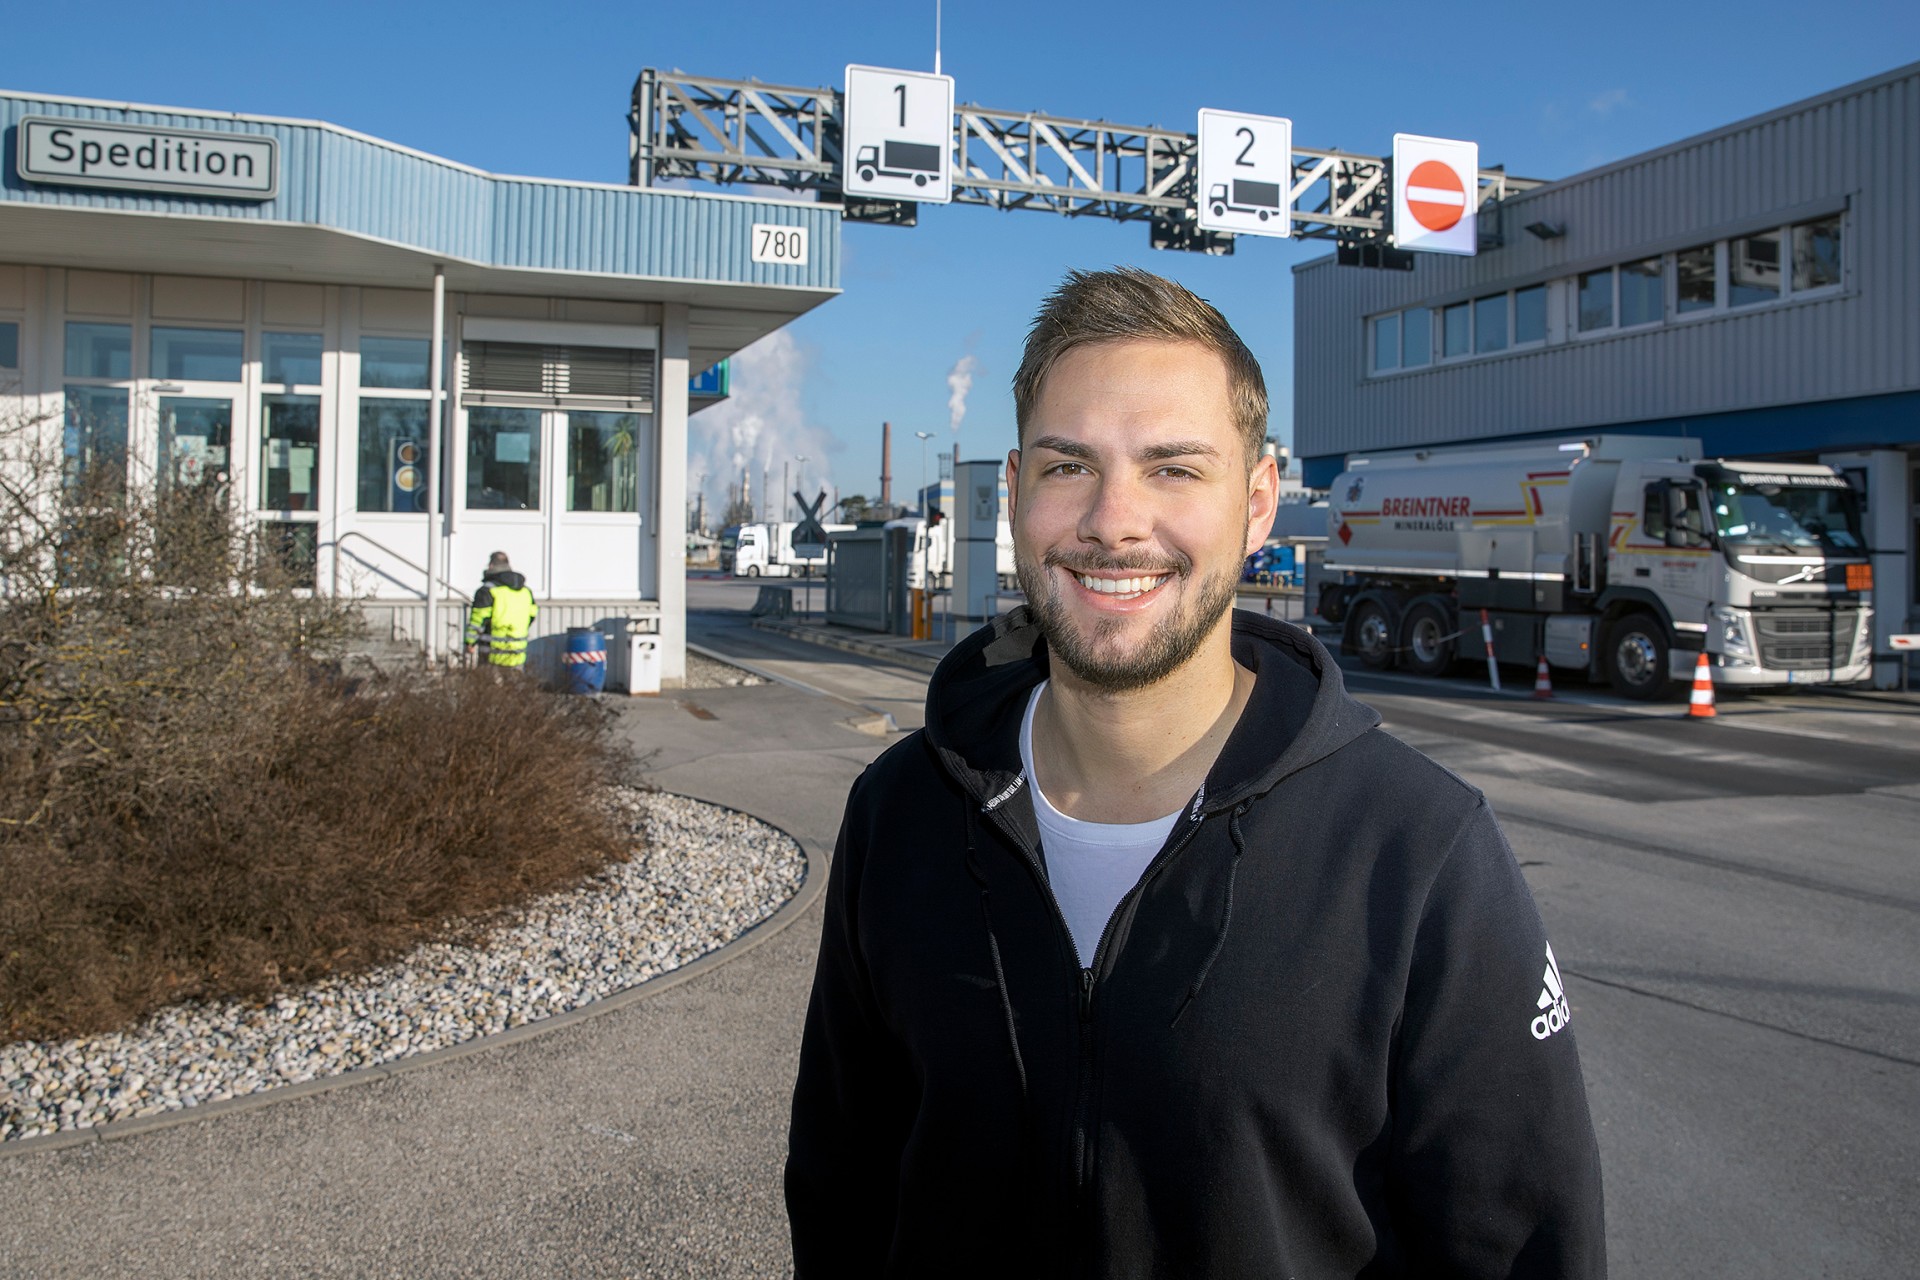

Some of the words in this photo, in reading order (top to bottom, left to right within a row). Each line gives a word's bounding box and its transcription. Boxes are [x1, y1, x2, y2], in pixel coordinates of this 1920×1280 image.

[893, 84, 907, 128] 1
[48, 129, 254, 177] Spedition
[1234, 126, 1256, 167] 2
[759, 229, 801, 259] 780
[1382, 496, 1471, 518] BREINTNER
[1394, 518, 1455, 532] MINERALÖLE
[1530, 995, 1571, 1041] adid
